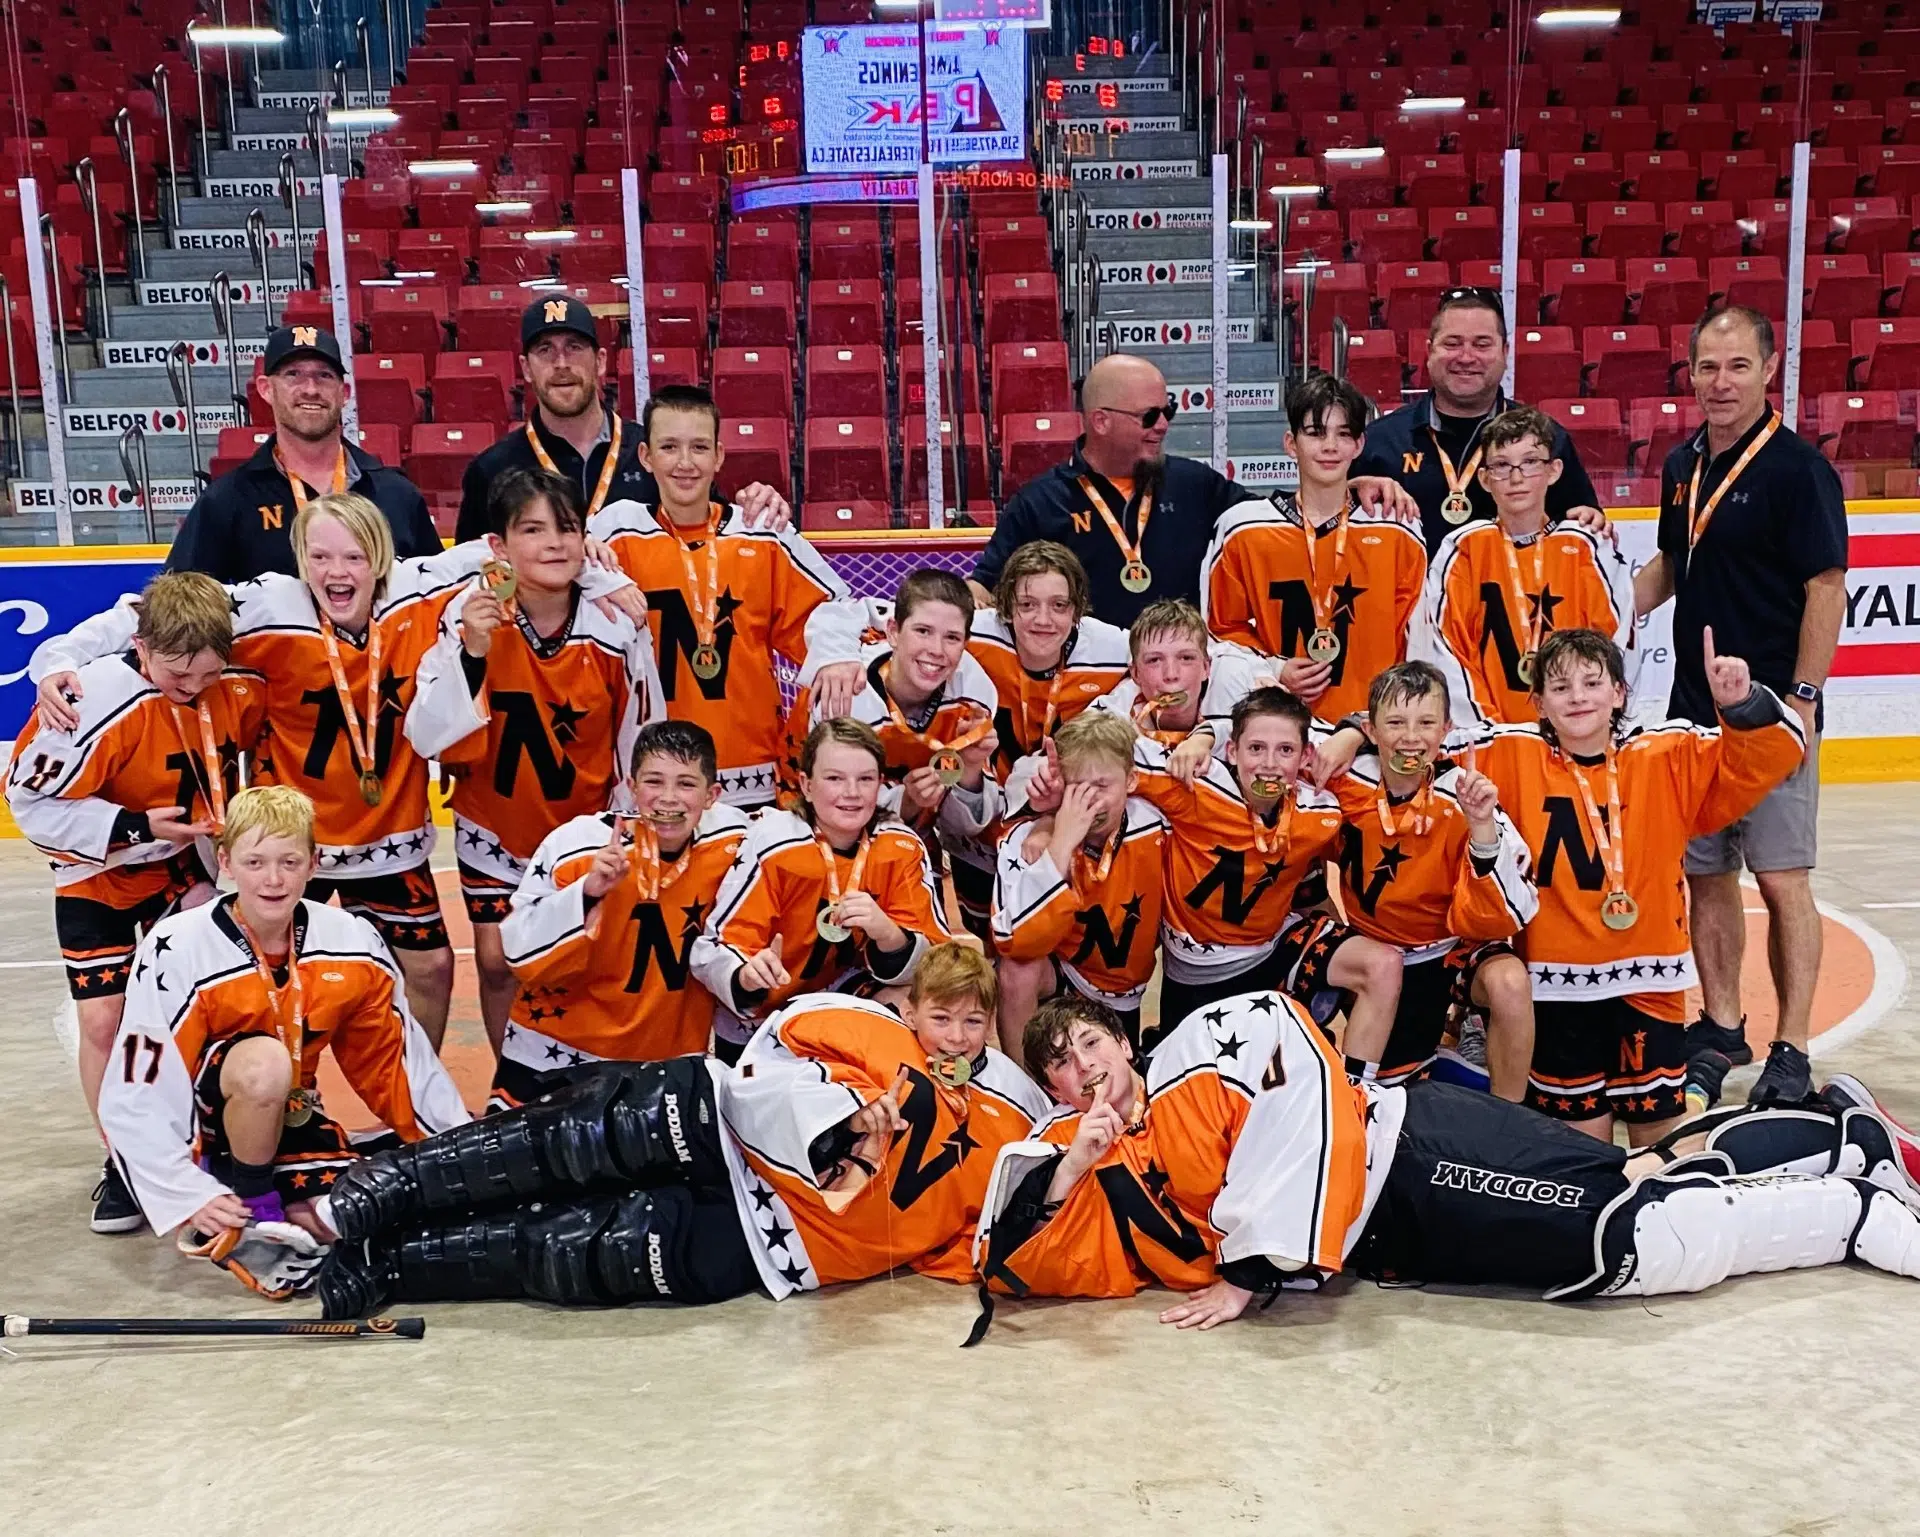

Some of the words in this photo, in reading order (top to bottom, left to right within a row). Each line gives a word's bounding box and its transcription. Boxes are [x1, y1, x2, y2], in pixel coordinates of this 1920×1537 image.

[1123, 82, 1165, 90] PROPERTY
[1133, 121, 1177, 129] PROPERTY
[237, 138, 298, 150] BELFOR
[1148, 165, 1193, 174] PROPERTY
[210, 183, 274, 197] BELFOR
[1067, 214, 1129, 229] BLFOR
[1166, 213, 1213, 221] PROPERTY
[179, 235, 246, 249] BELFOR
[1075, 266, 1143, 284] BLFOR
[256, 285, 306, 294] POPERTY
[544, 300, 568, 324] N
[292, 326, 318, 347] N
[1086, 326, 1157, 344] BEFOR
[225, 345, 266, 354] POPER
[69, 413, 147, 431] BELFOR
[1242, 461, 1298, 472] PROPERTY
[1403, 452, 1424, 473] N
[1242, 471, 1298, 480] RESTORATION
[20, 488, 103, 506] BEOR
[258, 504, 284, 530] N
[1071, 511, 1092, 534] N
[646, 586, 741, 700] N
[492, 691, 584, 800] N
[1536, 796, 1613, 891] N
[624, 902, 706, 993] N
[121, 1033, 165, 1085] 17
[664, 1092, 693, 1163] BODDAM
[1431, 1159, 1586, 1210] BODDAM
